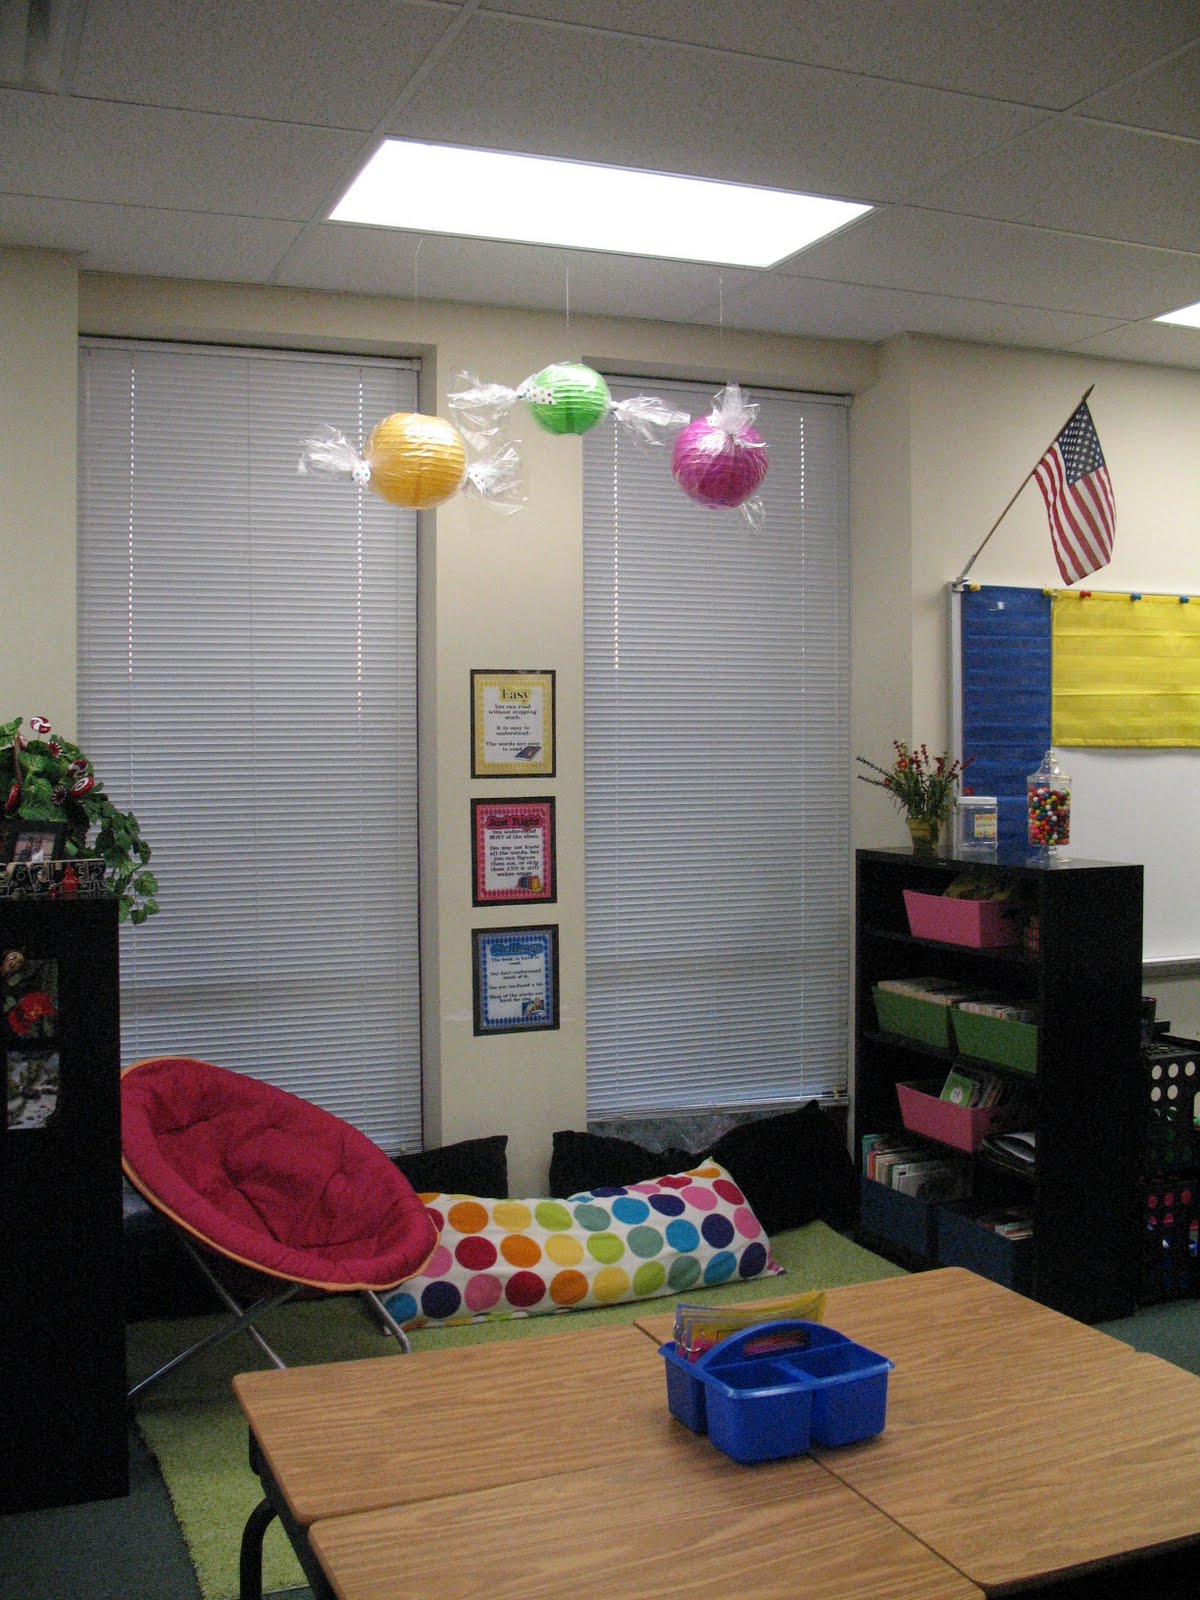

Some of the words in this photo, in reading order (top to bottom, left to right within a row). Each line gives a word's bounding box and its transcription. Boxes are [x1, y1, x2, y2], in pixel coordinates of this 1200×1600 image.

[502, 688, 529, 702] Easy
[488, 818, 508, 827] Just
[511, 817, 540, 828] Right
